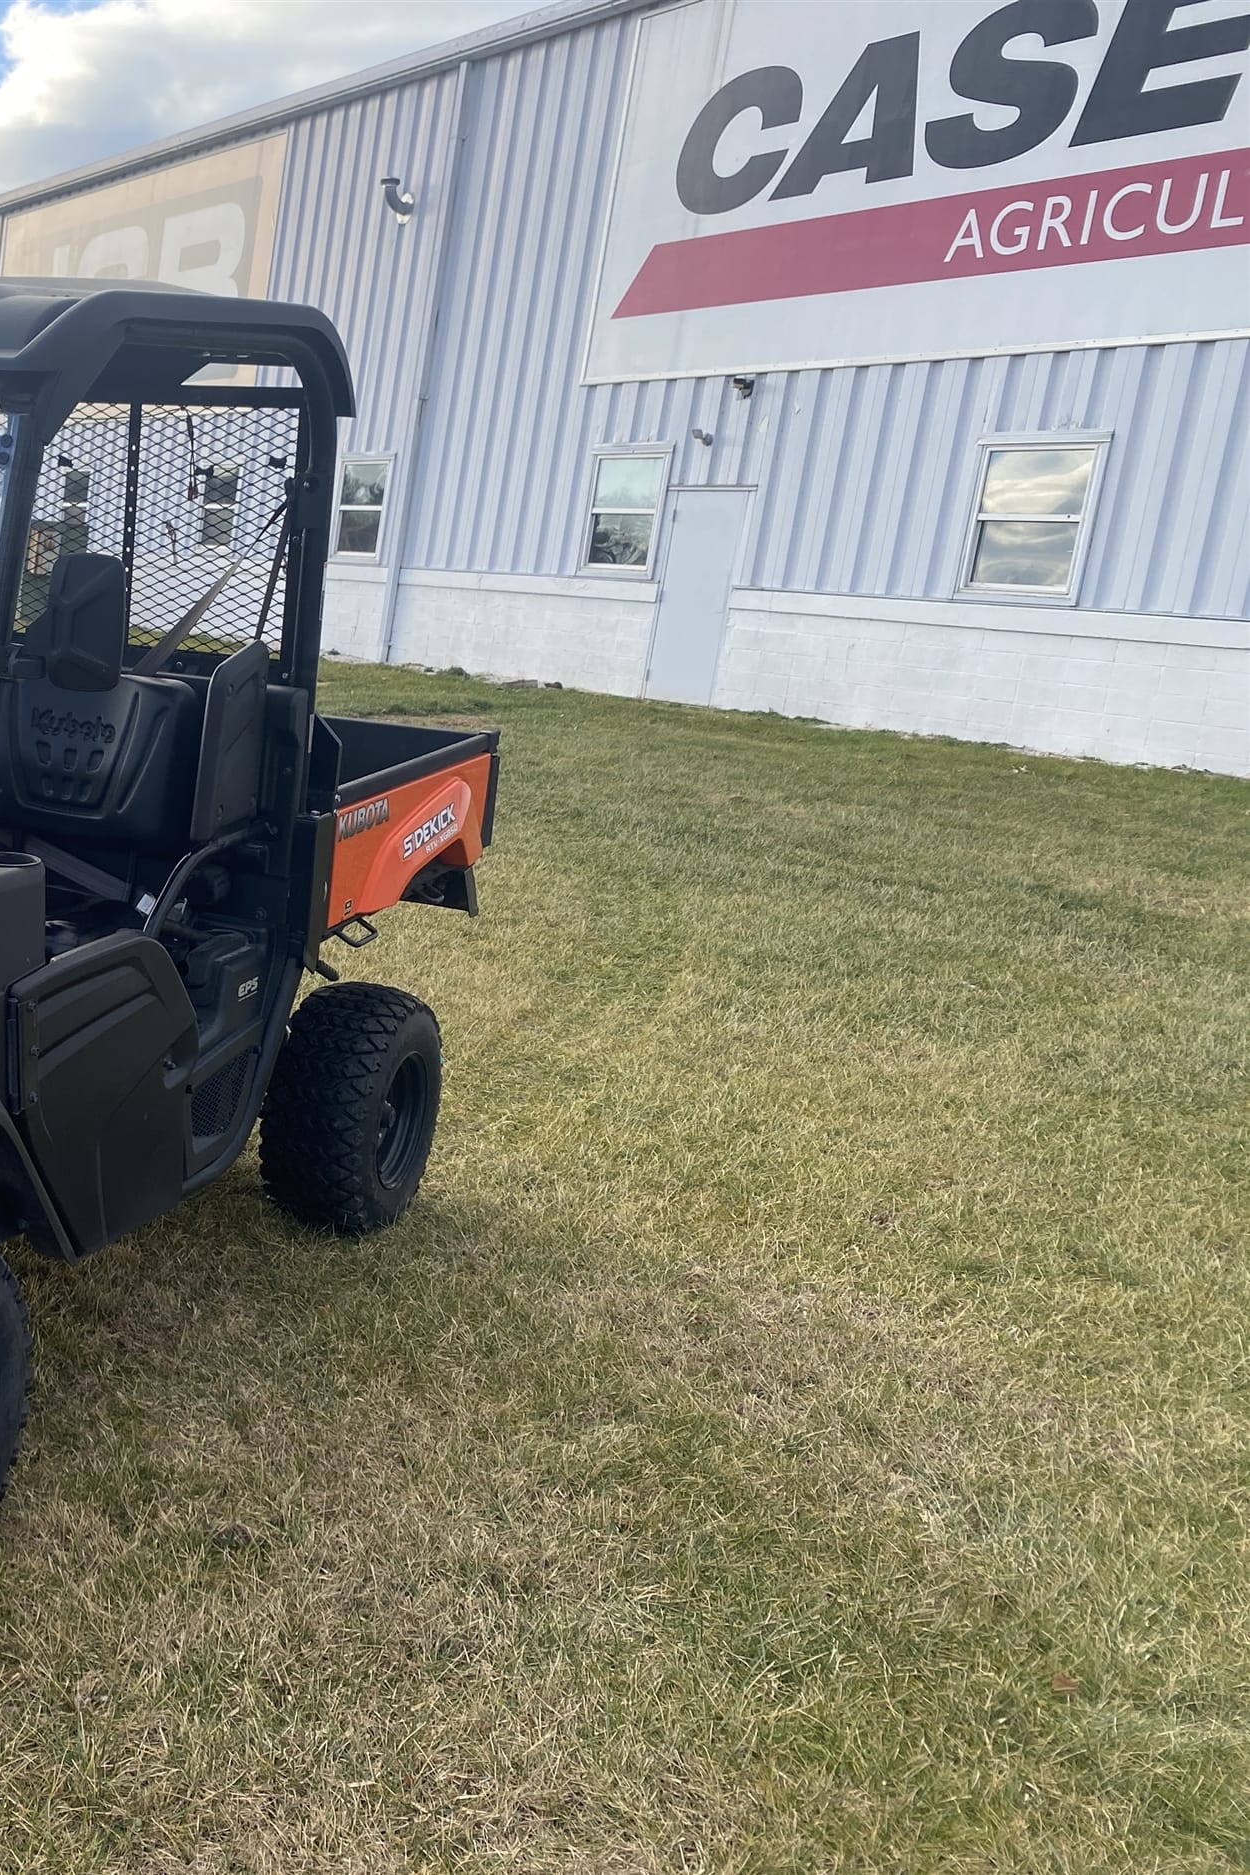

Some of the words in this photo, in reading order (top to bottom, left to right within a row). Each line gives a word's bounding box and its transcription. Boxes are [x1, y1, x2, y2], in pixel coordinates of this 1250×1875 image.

[676, 0, 1250, 215] CASE
[338, 797, 390, 842] KUBOTA
[403, 802, 456, 859] SIDEKICK
[238, 975, 259, 998] EPS
